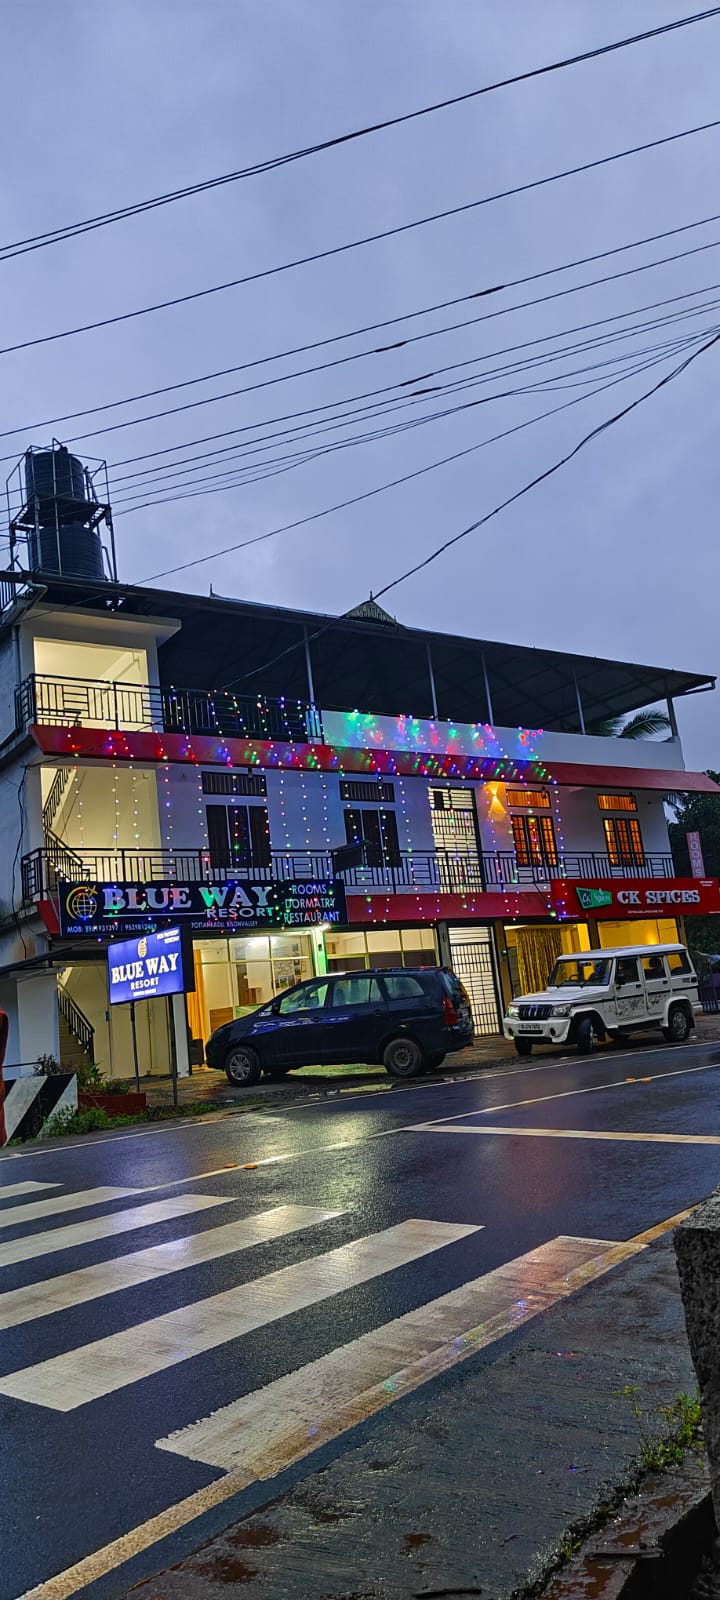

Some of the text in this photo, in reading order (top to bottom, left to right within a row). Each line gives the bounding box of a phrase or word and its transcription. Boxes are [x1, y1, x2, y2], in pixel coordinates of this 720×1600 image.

[690, 833, 702, 877] ROOMS
[291, 884, 327, 895] ROOMS
[102, 886, 273, 910] BLUE WAY
[285, 898, 336, 909] DORMATRY
[617, 890, 700, 904] CK SPICES
[206, 907, 275, 918] RESORT
[283, 911, 340, 923] RESTAURANT
[111, 953, 179, 984] BLUE WAY
[130, 977, 159, 990] RESORT
